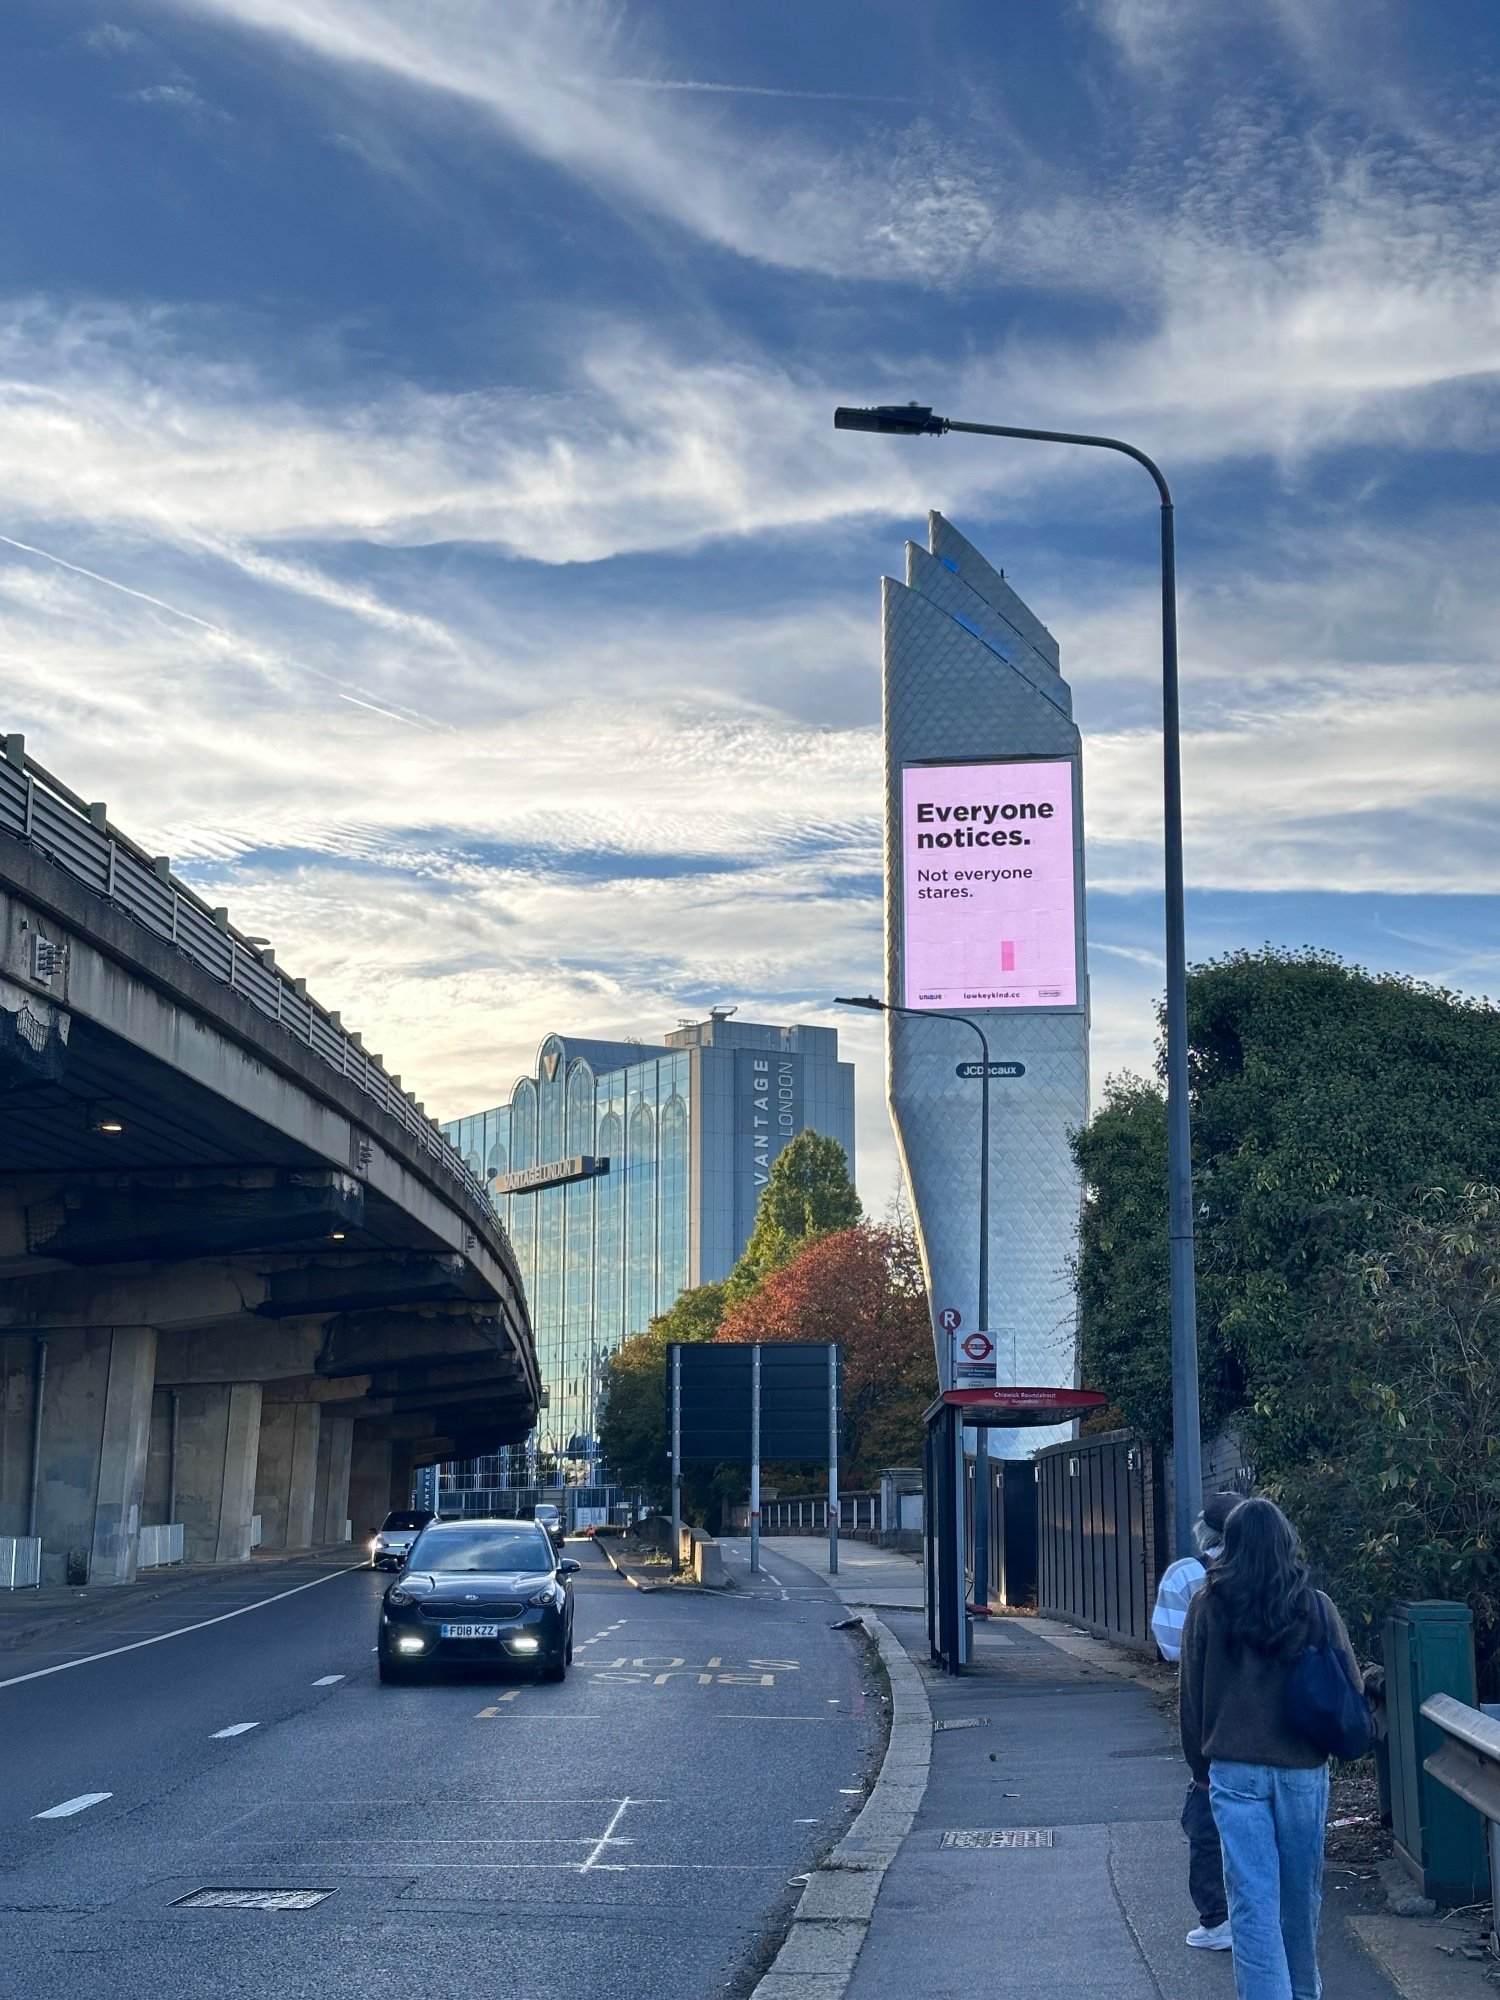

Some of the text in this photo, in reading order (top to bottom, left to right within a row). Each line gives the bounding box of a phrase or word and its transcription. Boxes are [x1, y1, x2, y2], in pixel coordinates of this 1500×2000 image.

[917, 802, 1054, 824] Everyone
[917, 827, 1031, 849] notices.
[918, 867, 1033, 884] Not everyone
[918, 886, 974, 899] stares.
[963, 991, 1021, 999] lowkeykind.cc
[963, 1065, 1017, 1076] JCDcaux
[778, 1062, 794, 1137] LONDON
[753, 1060, 769, 1186] VANTAGE
[944, 1311, 956, 1327] R
[450, 1625, 495, 1636] FD18 KZZ
[573, 1657, 800, 1670] STOP
[587, 1672, 775, 1686] BUS
